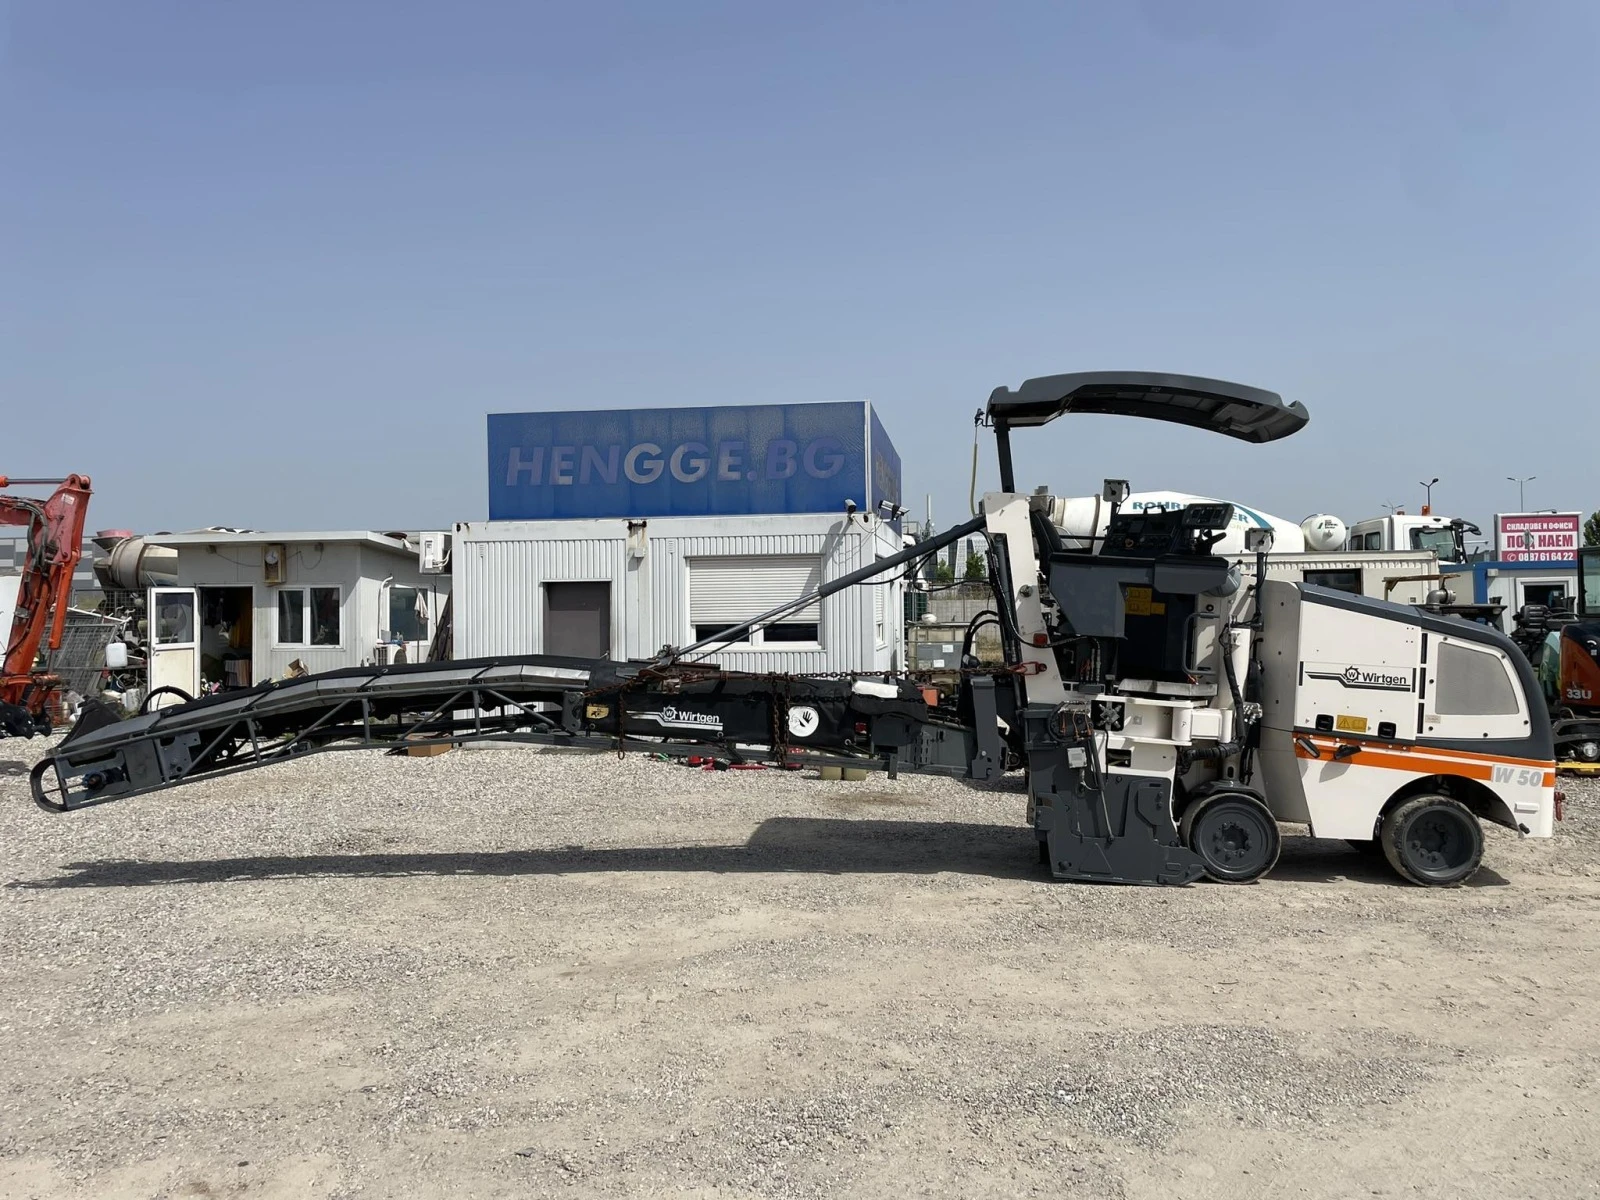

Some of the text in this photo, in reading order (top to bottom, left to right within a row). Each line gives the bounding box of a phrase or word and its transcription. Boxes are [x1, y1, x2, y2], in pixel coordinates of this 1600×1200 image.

[505, 436, 846, 487] HENGGE.BG
[1538, 534, 1574, 548] НАЕМ
[1540, 552, 1550, 561] 61
[1551, 552, 1562, 561] 64
[1563, 551, 1574, 561] 22
[1362, 672, 1407, 686] Wirtgen
[678, 710, 720, 723] Wirtgen
[1495, 766, 1543, 787] W 50
